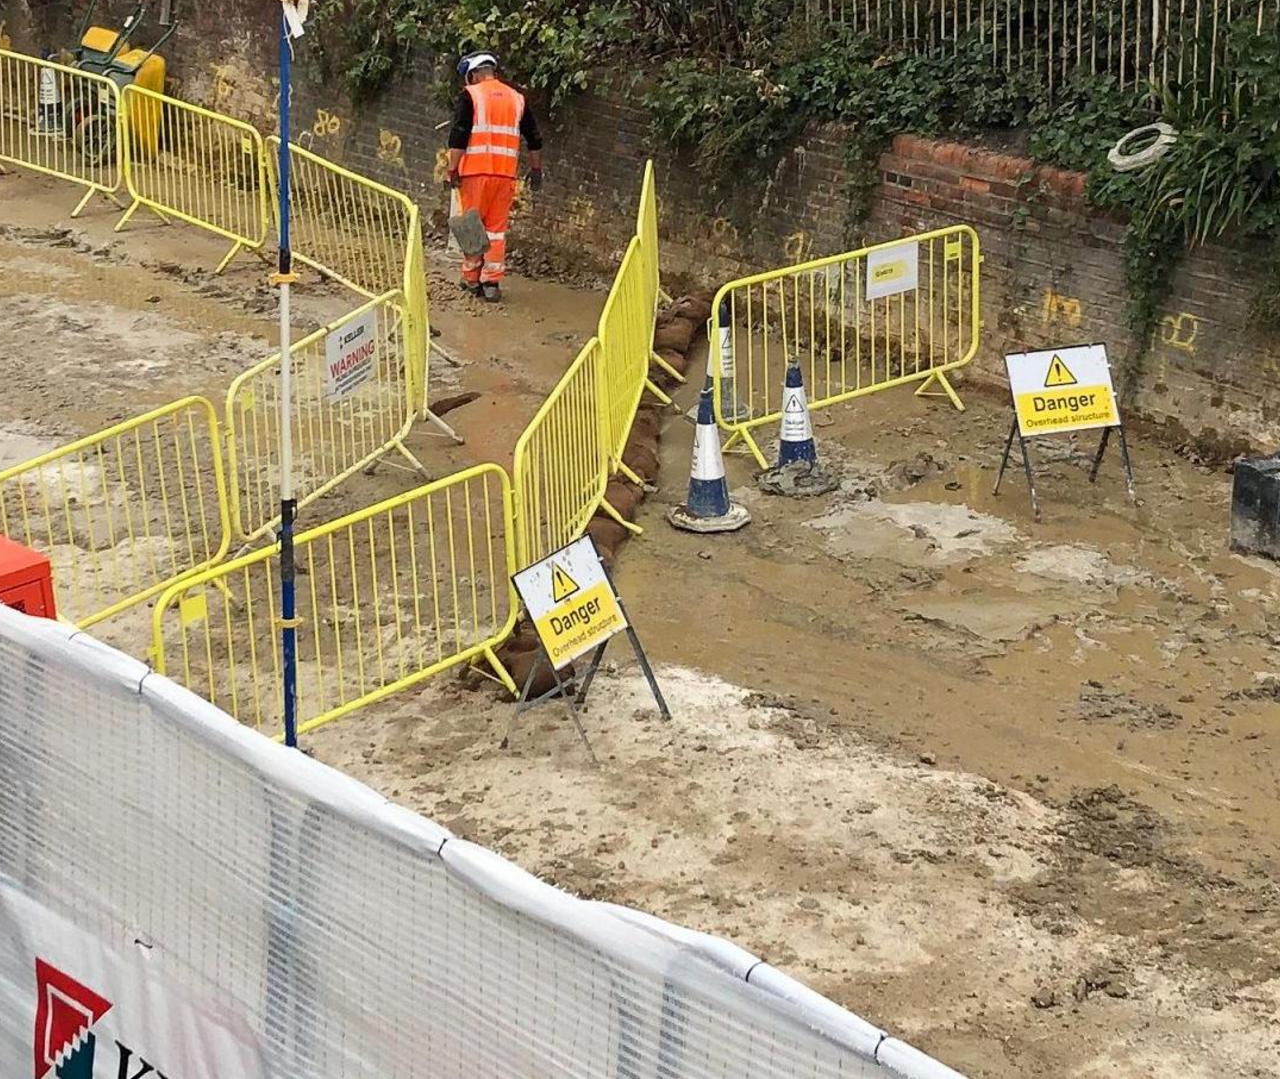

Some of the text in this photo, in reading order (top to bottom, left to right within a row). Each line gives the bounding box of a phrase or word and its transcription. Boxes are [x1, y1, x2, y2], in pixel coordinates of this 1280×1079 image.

[330, 338, 376, 379] WARNING
[1033, 394, 1096, 412] Danger
[1026, 415, 1069, 428] Overhead
[550, 596, 601, 636] Danger
